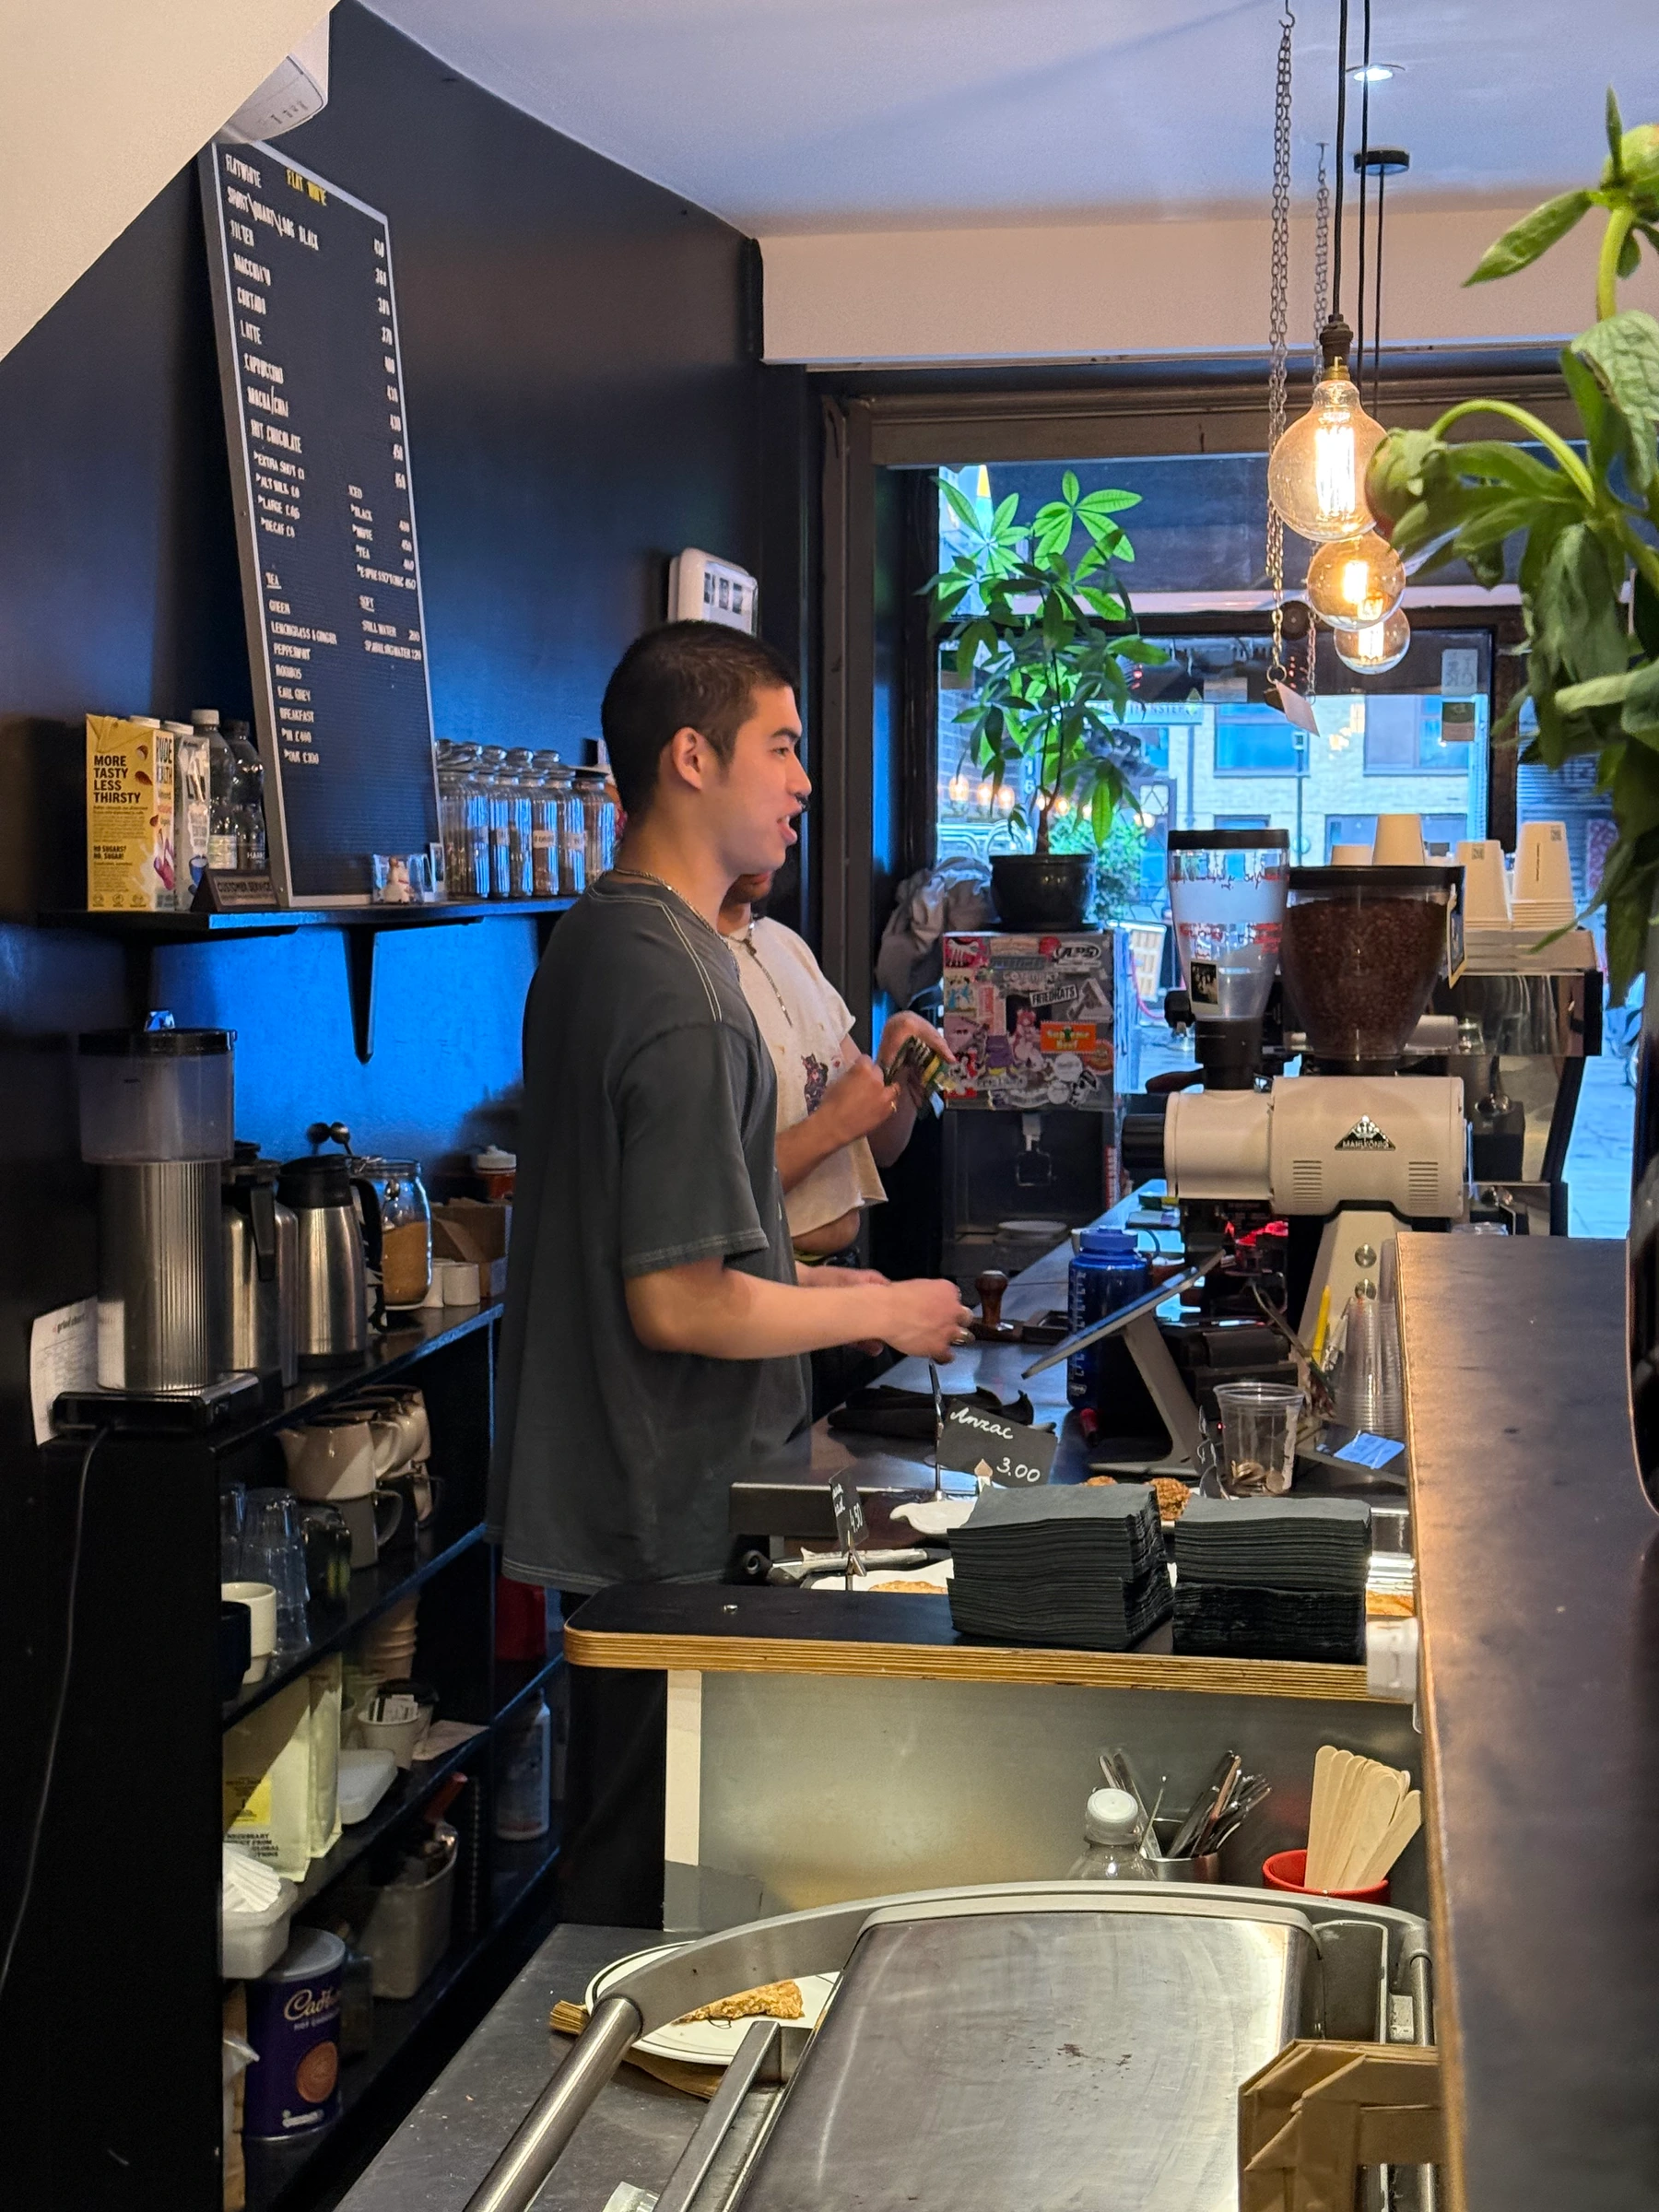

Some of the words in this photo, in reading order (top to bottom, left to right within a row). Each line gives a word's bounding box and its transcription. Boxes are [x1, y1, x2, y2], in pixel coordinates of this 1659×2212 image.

[286, 169, 303, 192] FLAT
[240, 320, 262, 345] LATTE
[93, 755, 127, 767] MORE
[93, 767, 128, 779] TASTY
[93, 780, 122, 791] LESS
[93, 792, 141, 804] THIRSTY
[218, 882, 247, 892] CUSTOMER
[247, 881, 272, 891] SERVICE
[996, 1457, 1041, 1483] 3.00
